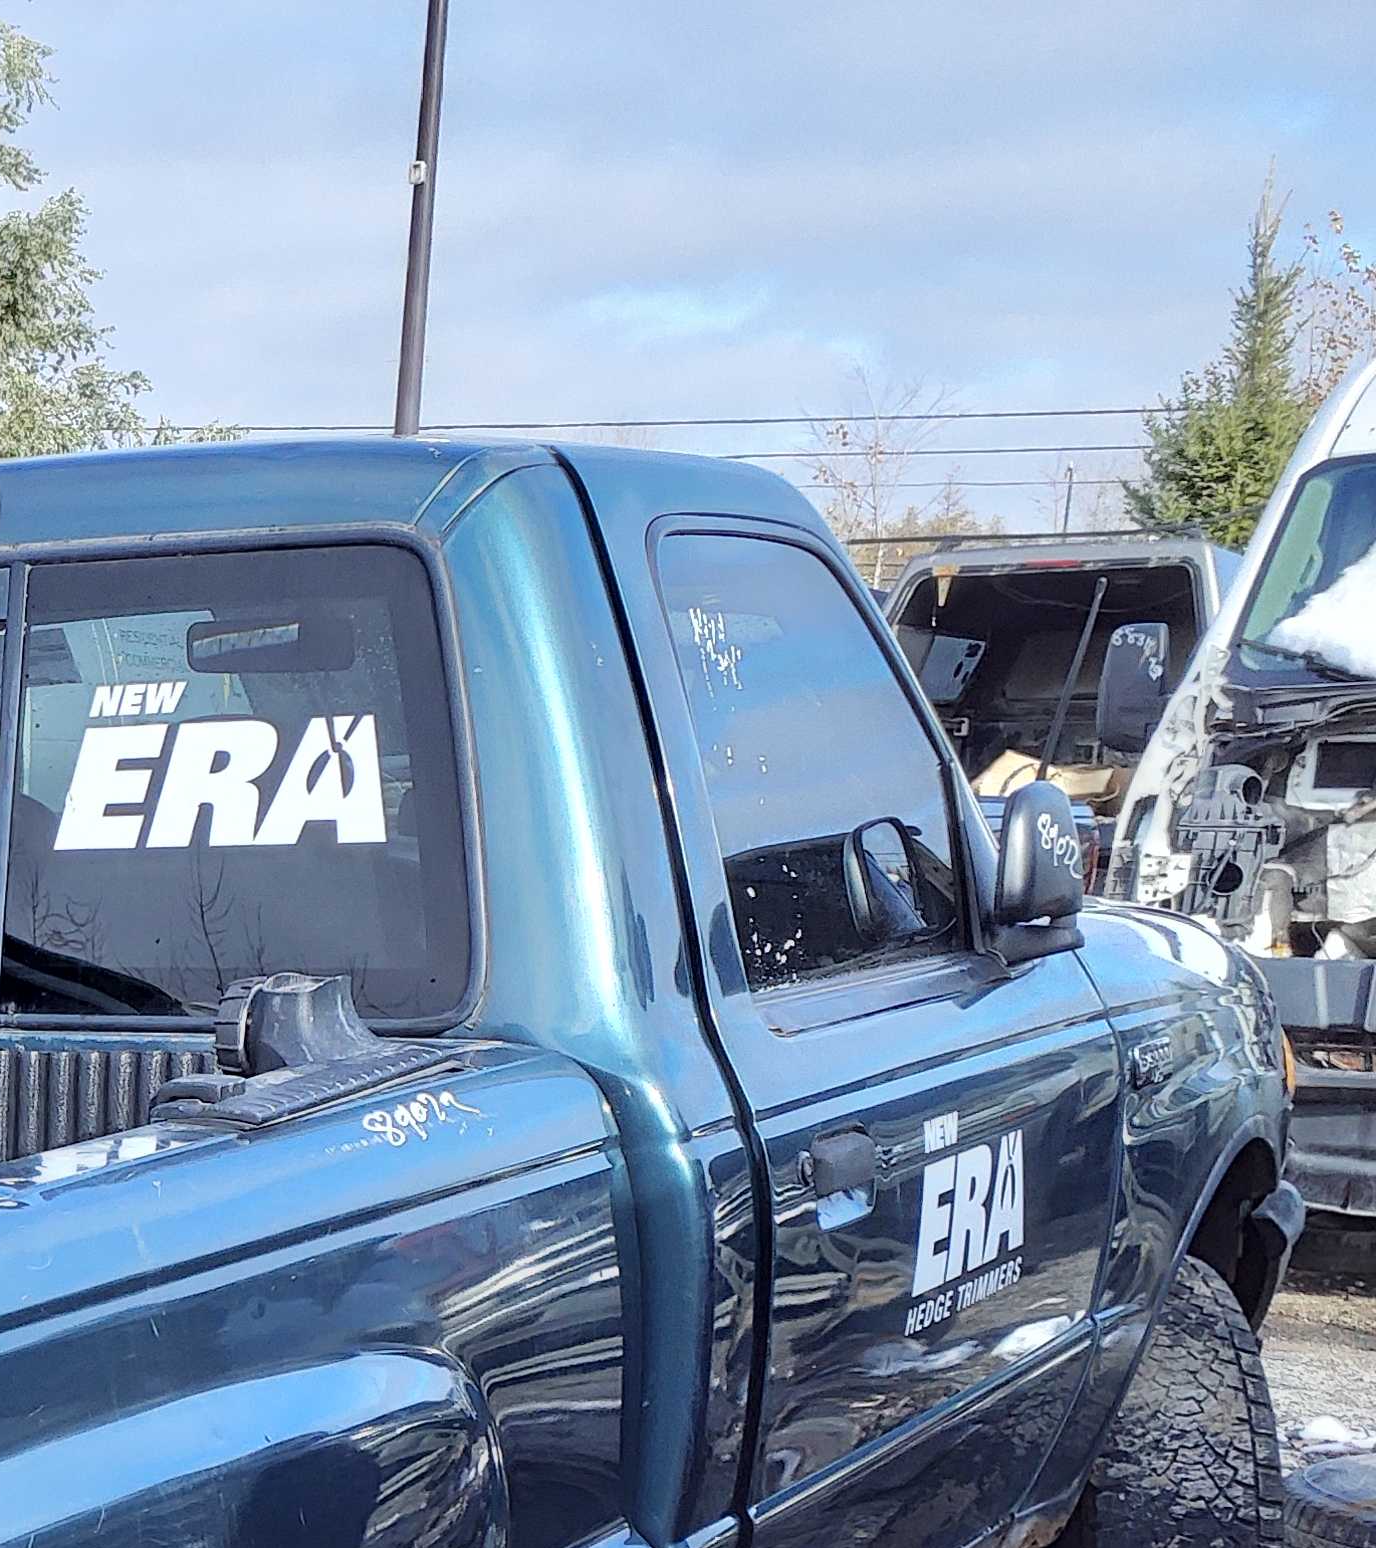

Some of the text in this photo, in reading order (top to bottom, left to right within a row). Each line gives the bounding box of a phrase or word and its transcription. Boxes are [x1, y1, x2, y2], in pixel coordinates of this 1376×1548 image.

[89, 680, 188, 717] NEW
[53, 714, 389, 851] ERA
[923, 1111, 959, 1154] NEW
[912, 1129, 1024, 1298] ERA
[905, 1256, 1023, 1337] HEDGE TRIMMERS
